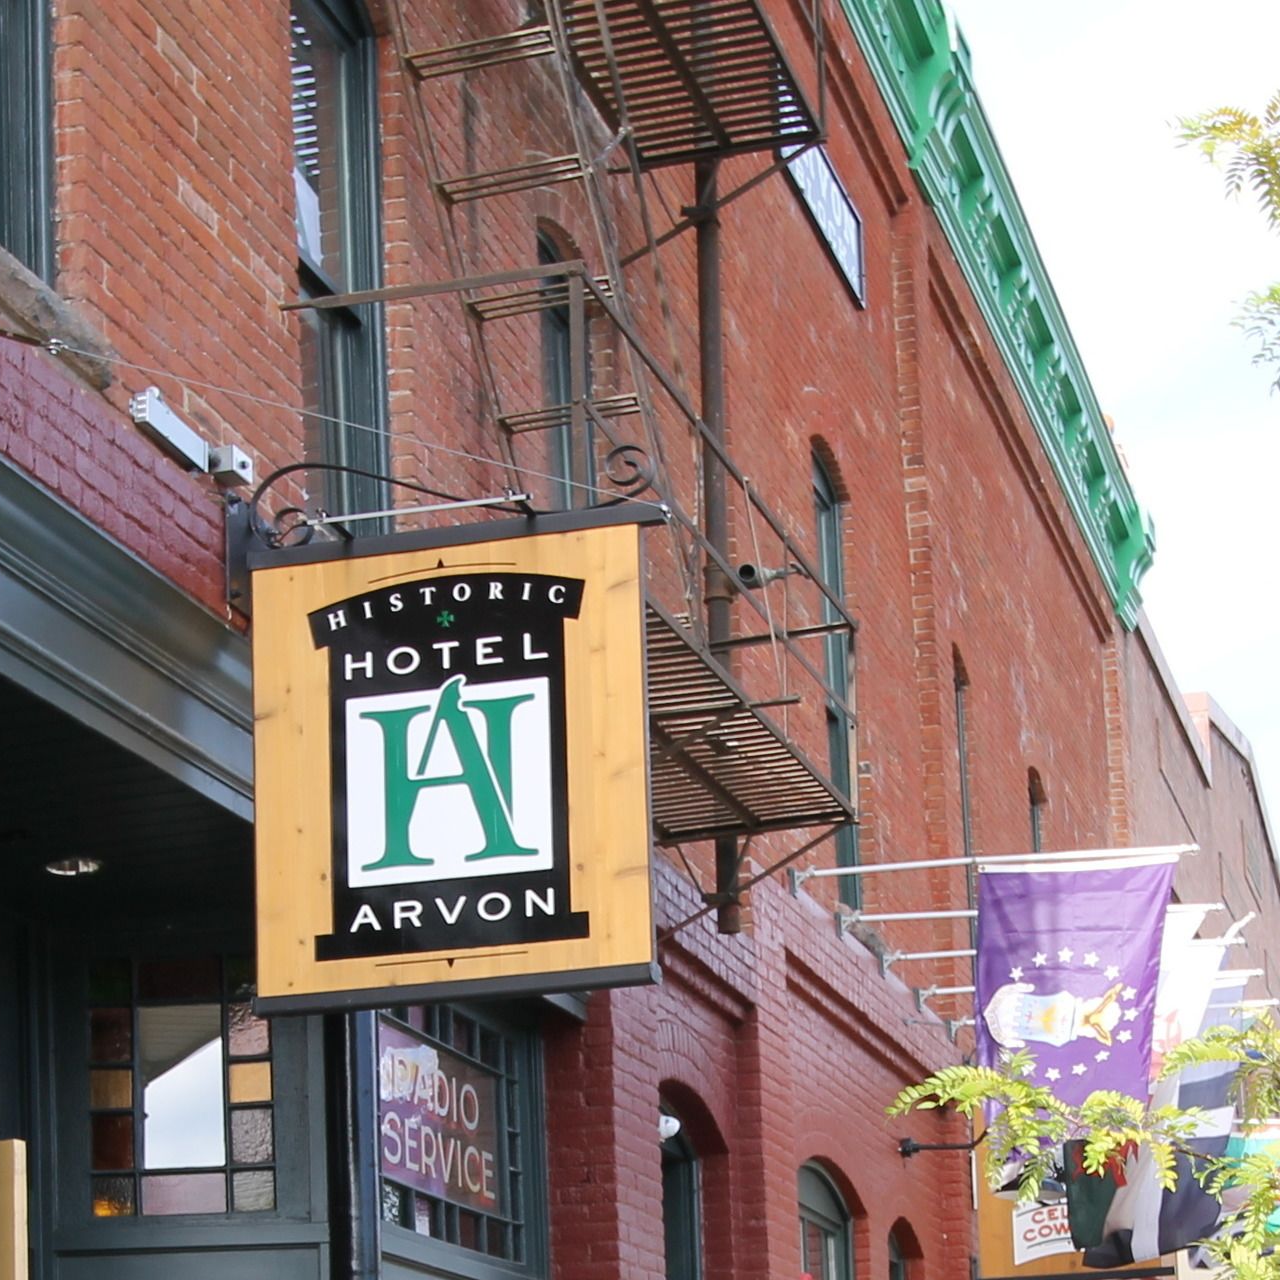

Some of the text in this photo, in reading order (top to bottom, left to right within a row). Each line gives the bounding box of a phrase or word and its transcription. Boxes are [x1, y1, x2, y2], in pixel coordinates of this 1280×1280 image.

[327, 582, 566, 631] HISTORIC
[344, 633, 548, 680] HOTEL
[350, 888, 556, 934] ARVON
[382, 1111, 496, 1199] SERVICE
[1023, 1222, 1072, 1242] COW
[1031, 1207, 1069, 1224] CEL
